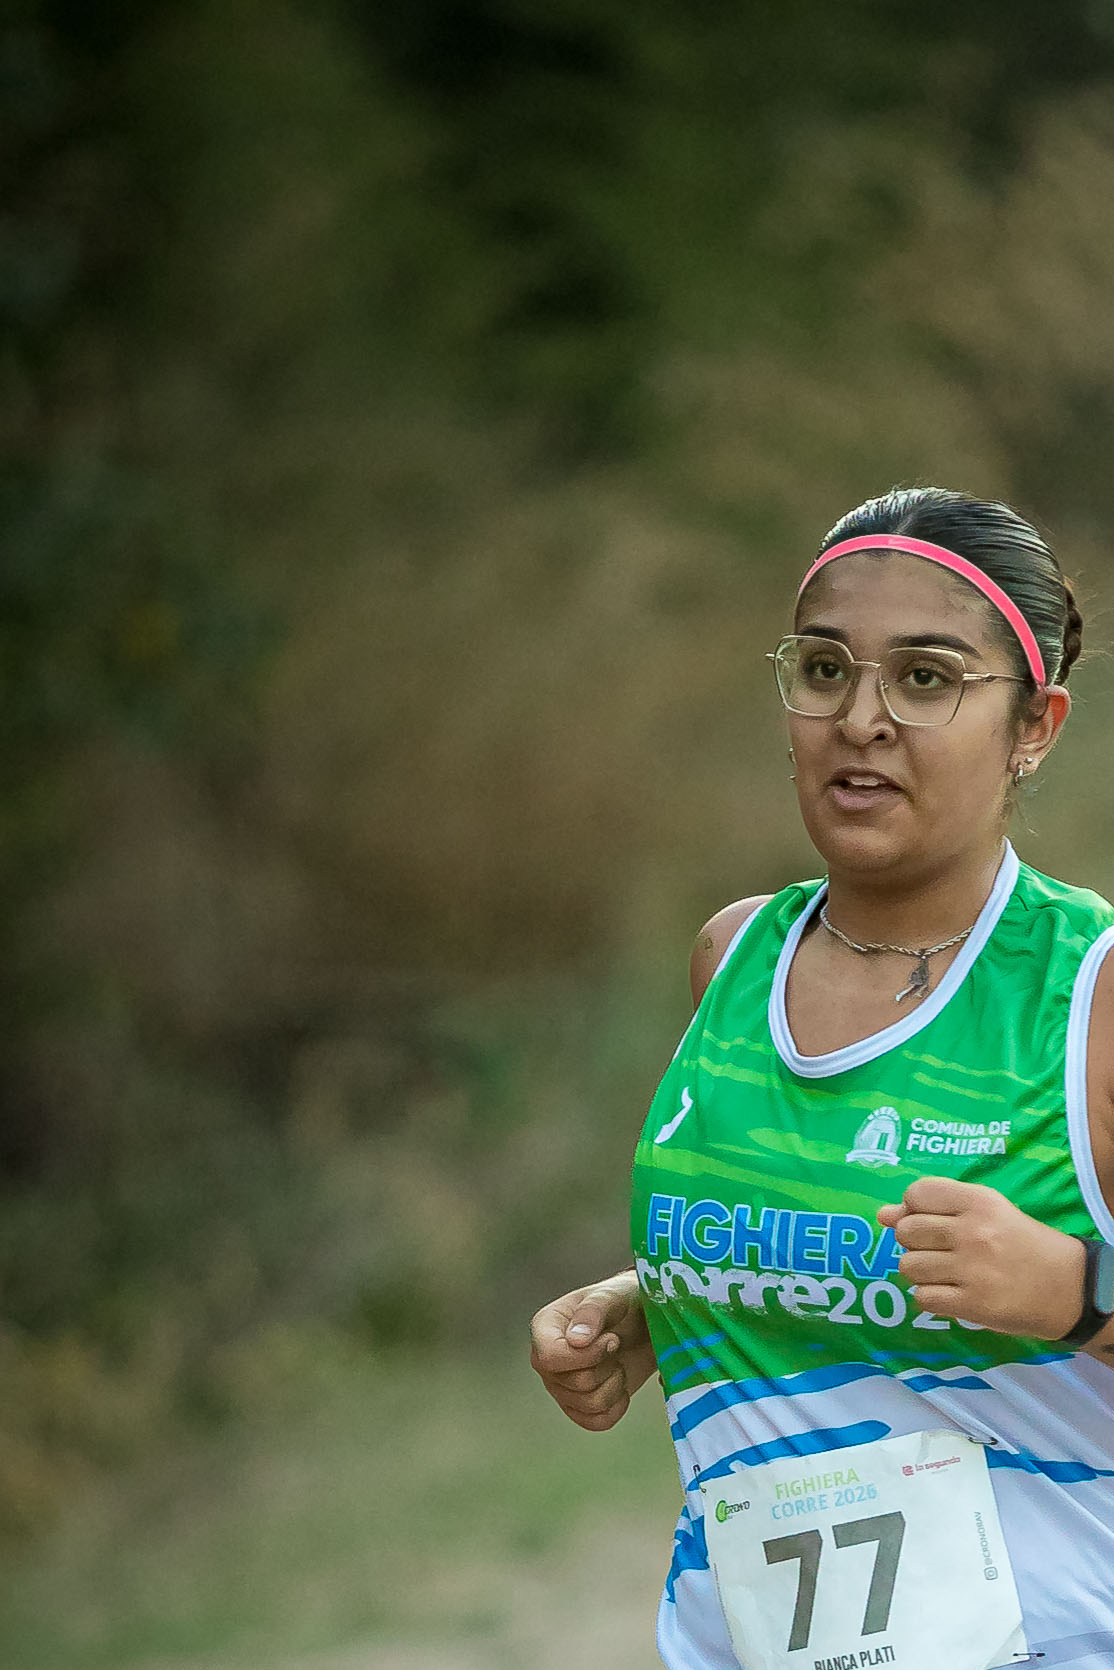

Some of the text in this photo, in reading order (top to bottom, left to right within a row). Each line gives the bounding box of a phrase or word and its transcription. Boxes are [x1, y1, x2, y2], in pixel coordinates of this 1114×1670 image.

[911, 1117, 1011, 1136] COMUNA DE
[906, 1133, 1006, 1155] FIGHIERA
[775, 1467, 860, 1500] FIGHIERA
[771, 1482, 878, 1520] CORRE 2026
[762, 1510, 906, 1652] 77
[859, 1645, 896, 1668] PLATI
